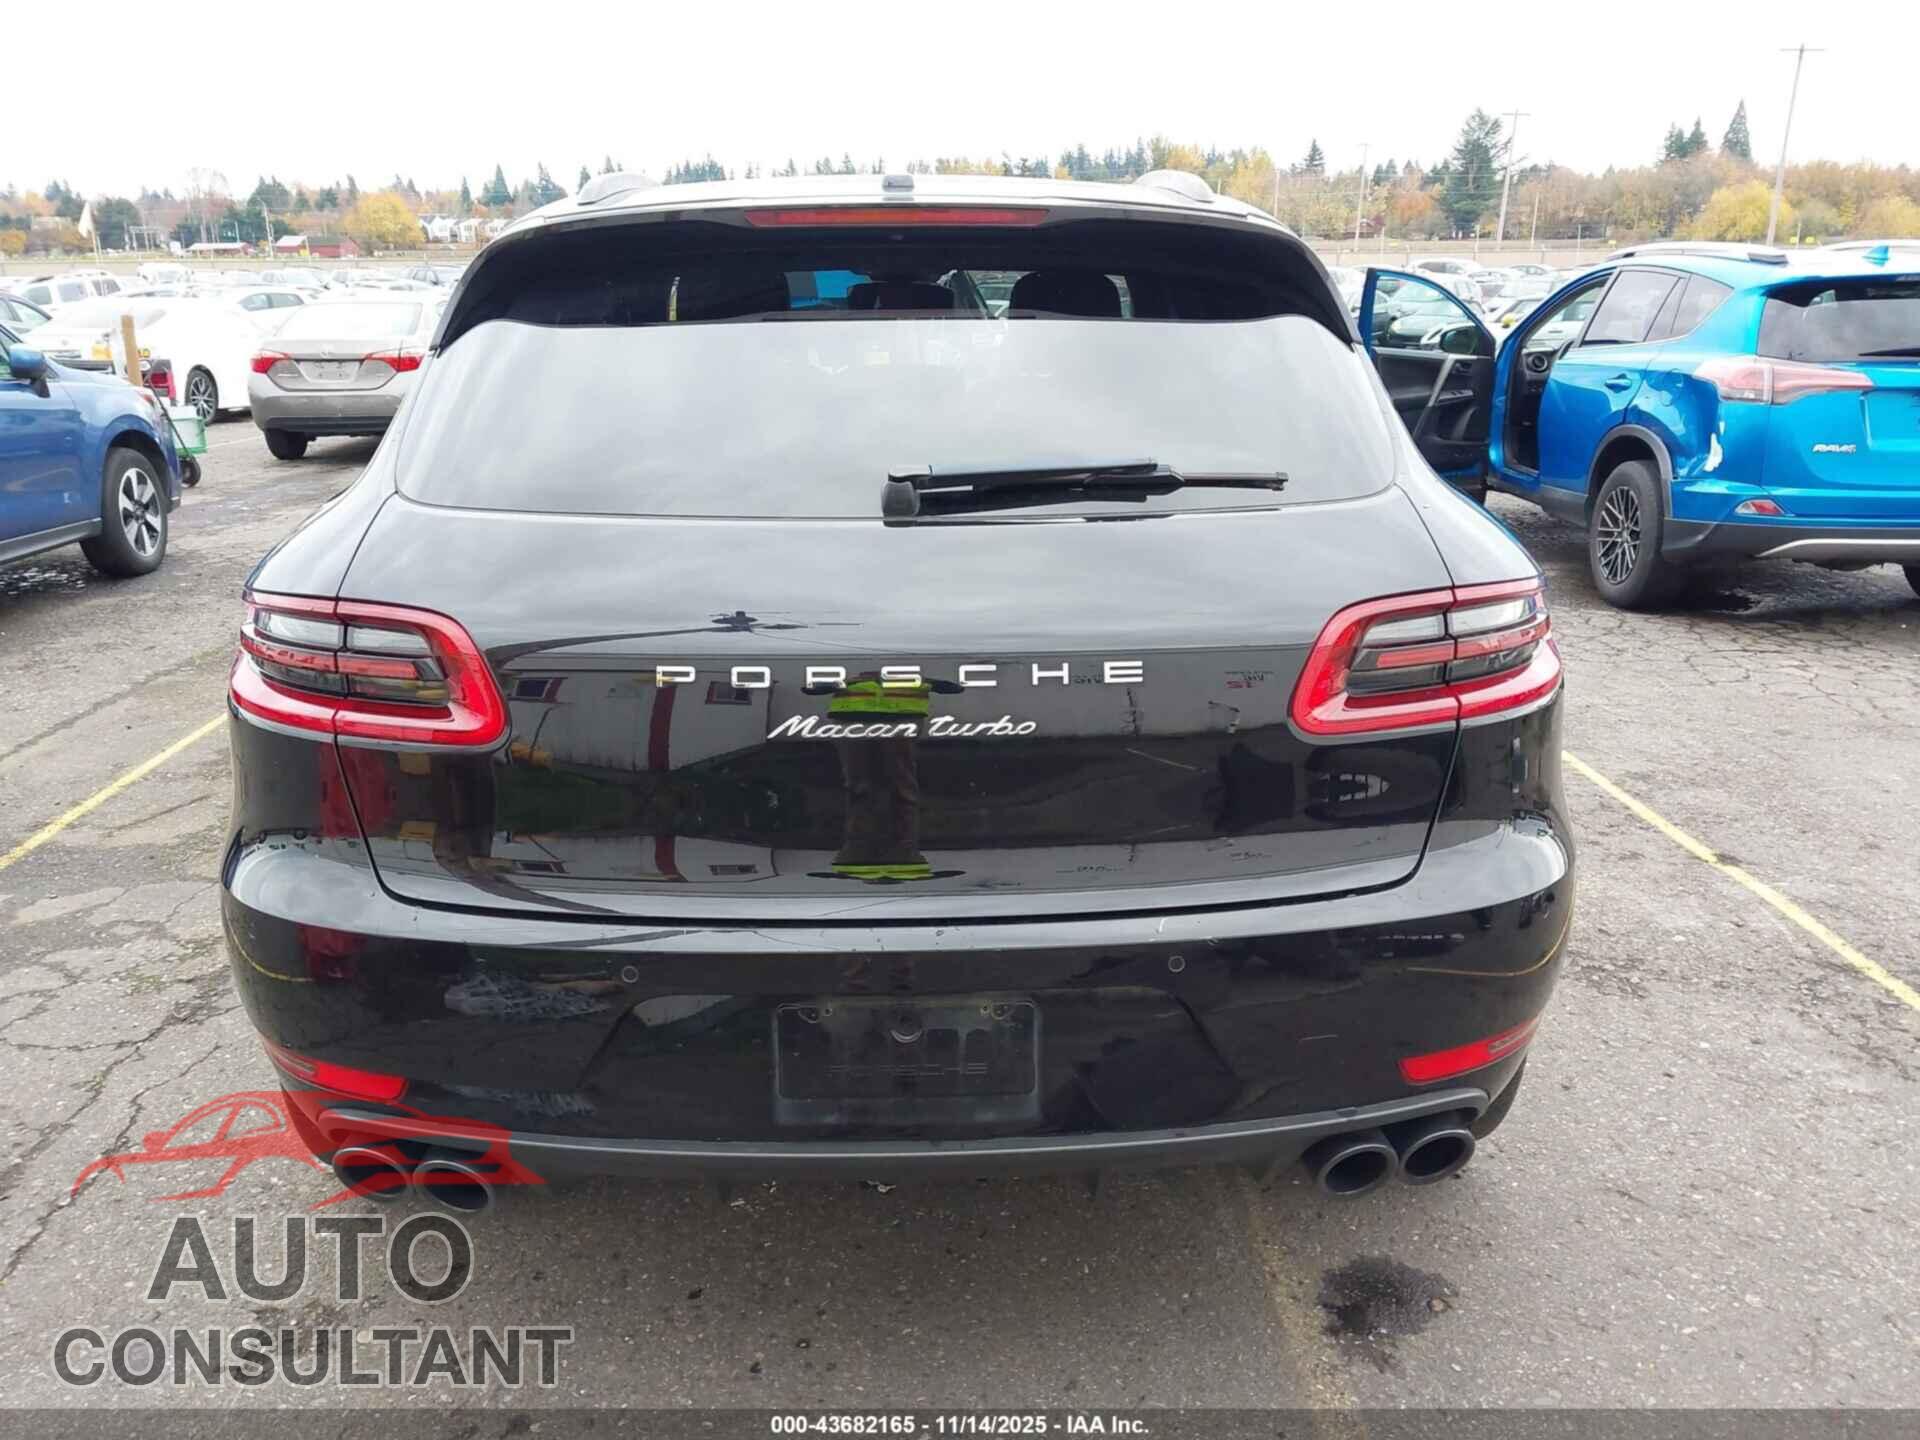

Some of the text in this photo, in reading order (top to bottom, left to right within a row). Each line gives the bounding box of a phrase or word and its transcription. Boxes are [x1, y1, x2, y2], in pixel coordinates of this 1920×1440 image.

[655, 660, 1144, 689] PORSCHE
[767, 714, 1037, 740] Macan turbo
